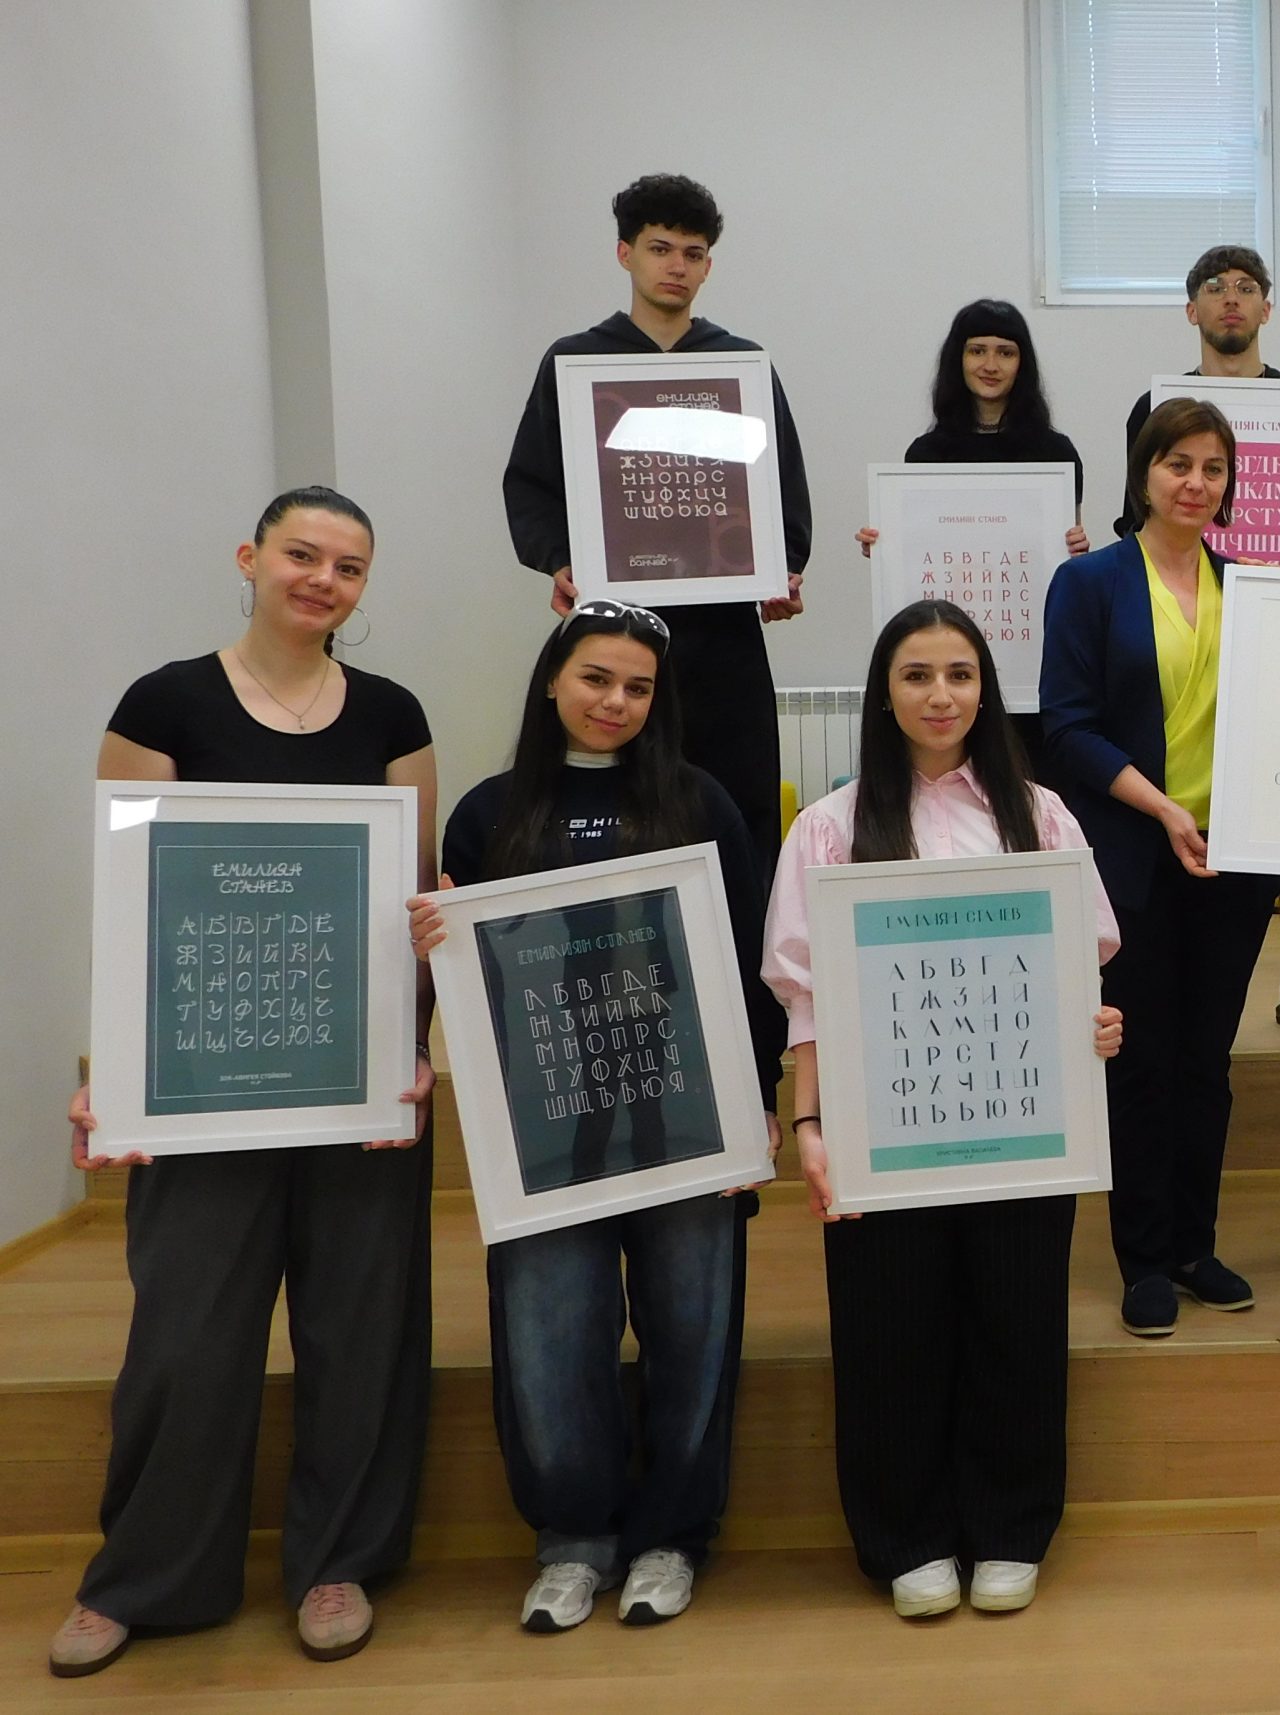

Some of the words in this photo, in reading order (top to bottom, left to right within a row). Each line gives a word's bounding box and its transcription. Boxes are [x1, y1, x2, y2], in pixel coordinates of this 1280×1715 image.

[581, 830, 602, 838] 1985
[211, 862, 303, 878] ЕМИЛИЯН
[219, 879, 294, 894] СТАНЕВ
[886, 912, 958, 929] ЕМИЛИЯН
[966, 908, 1022, 923] СТАНЕВ
[517, 935, 592, 965] ЕМИЛИЯН
[596, 926, 656, 950] СТАНЕВ
